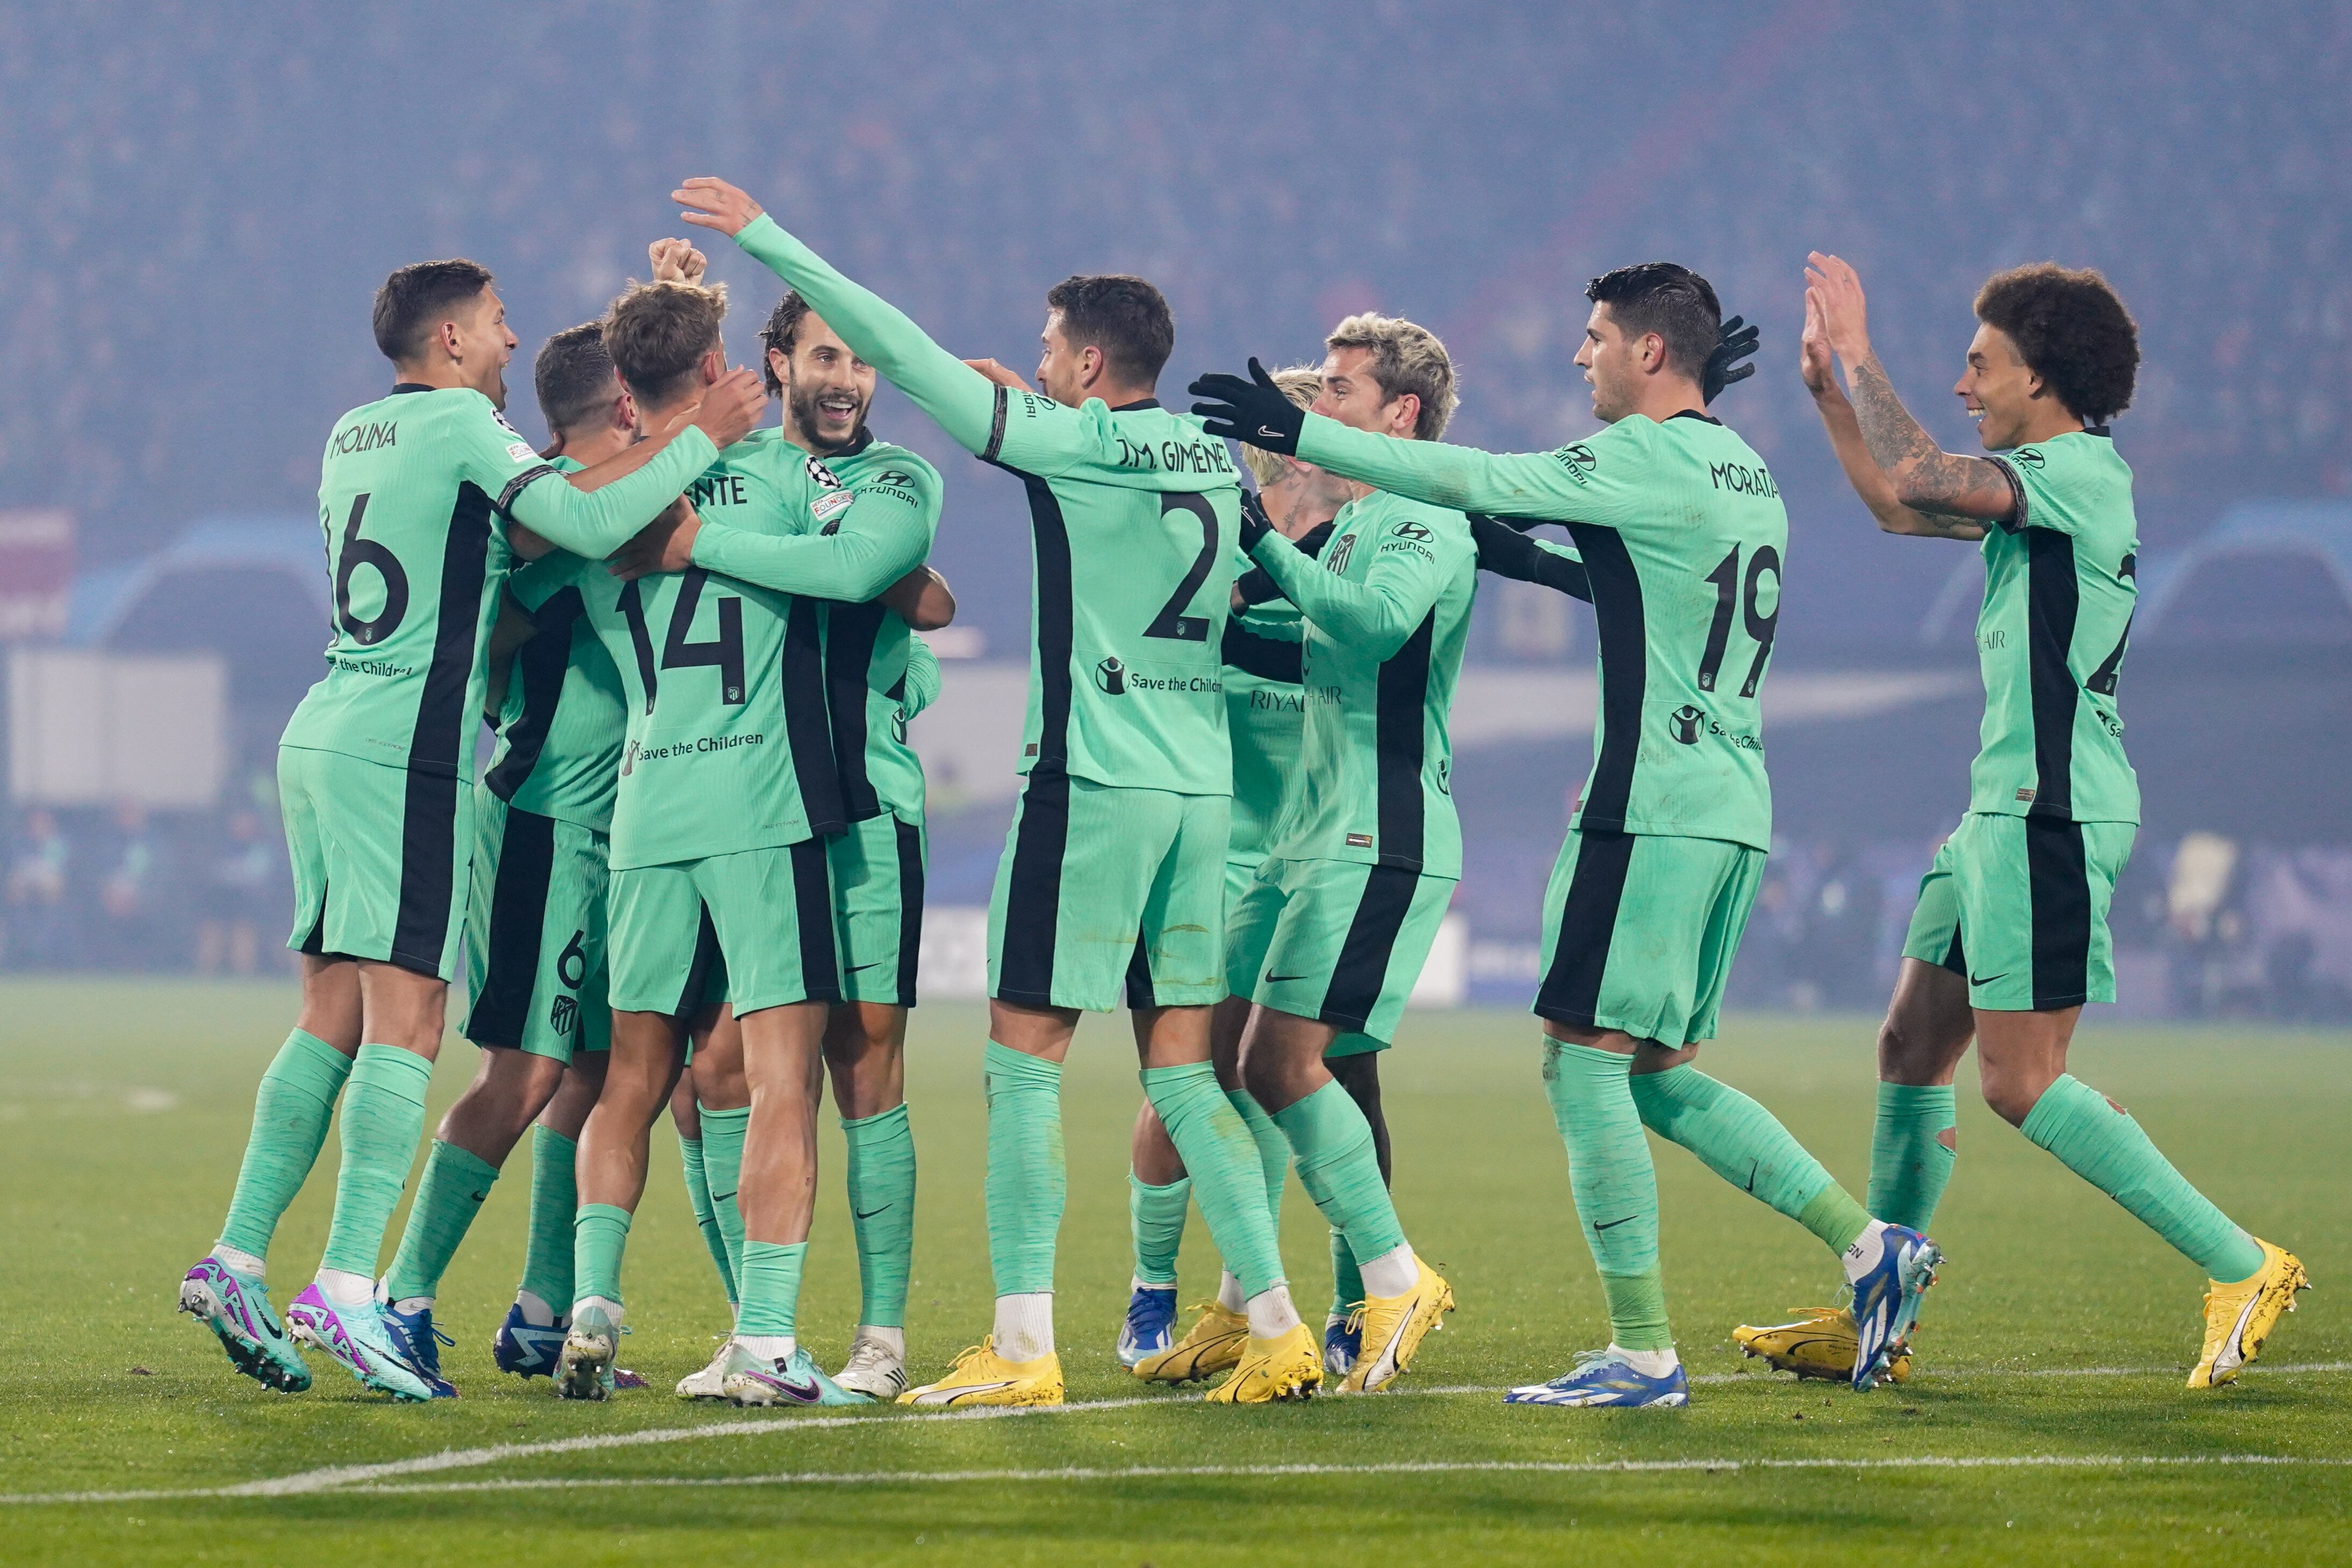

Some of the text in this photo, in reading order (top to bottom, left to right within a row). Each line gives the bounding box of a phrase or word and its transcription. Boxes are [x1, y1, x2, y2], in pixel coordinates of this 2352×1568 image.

[330, 421, 397, 458] MOLINA
[1116, 438, 1157, 469] J.M.
[1708, 460, 1779, 499] MORATA
[861, 486, 918, 508] HYUNDAI
[1141, 491, 1219, 642] 2
[1380, 541, 1435, 565] HYUNDAI
[1698, 540, 1781, 699] 19
[615, 565, 745, 716] 14
[1982, 630, 2005, 650] AIR
[340, 658, 359, 672] the
[1131, 673, 1165, 690] Save
[1168, 677, 1186, 692] the
[638, 733, 764, 761] Save the Children
[557, 929, 586, 990] 6
